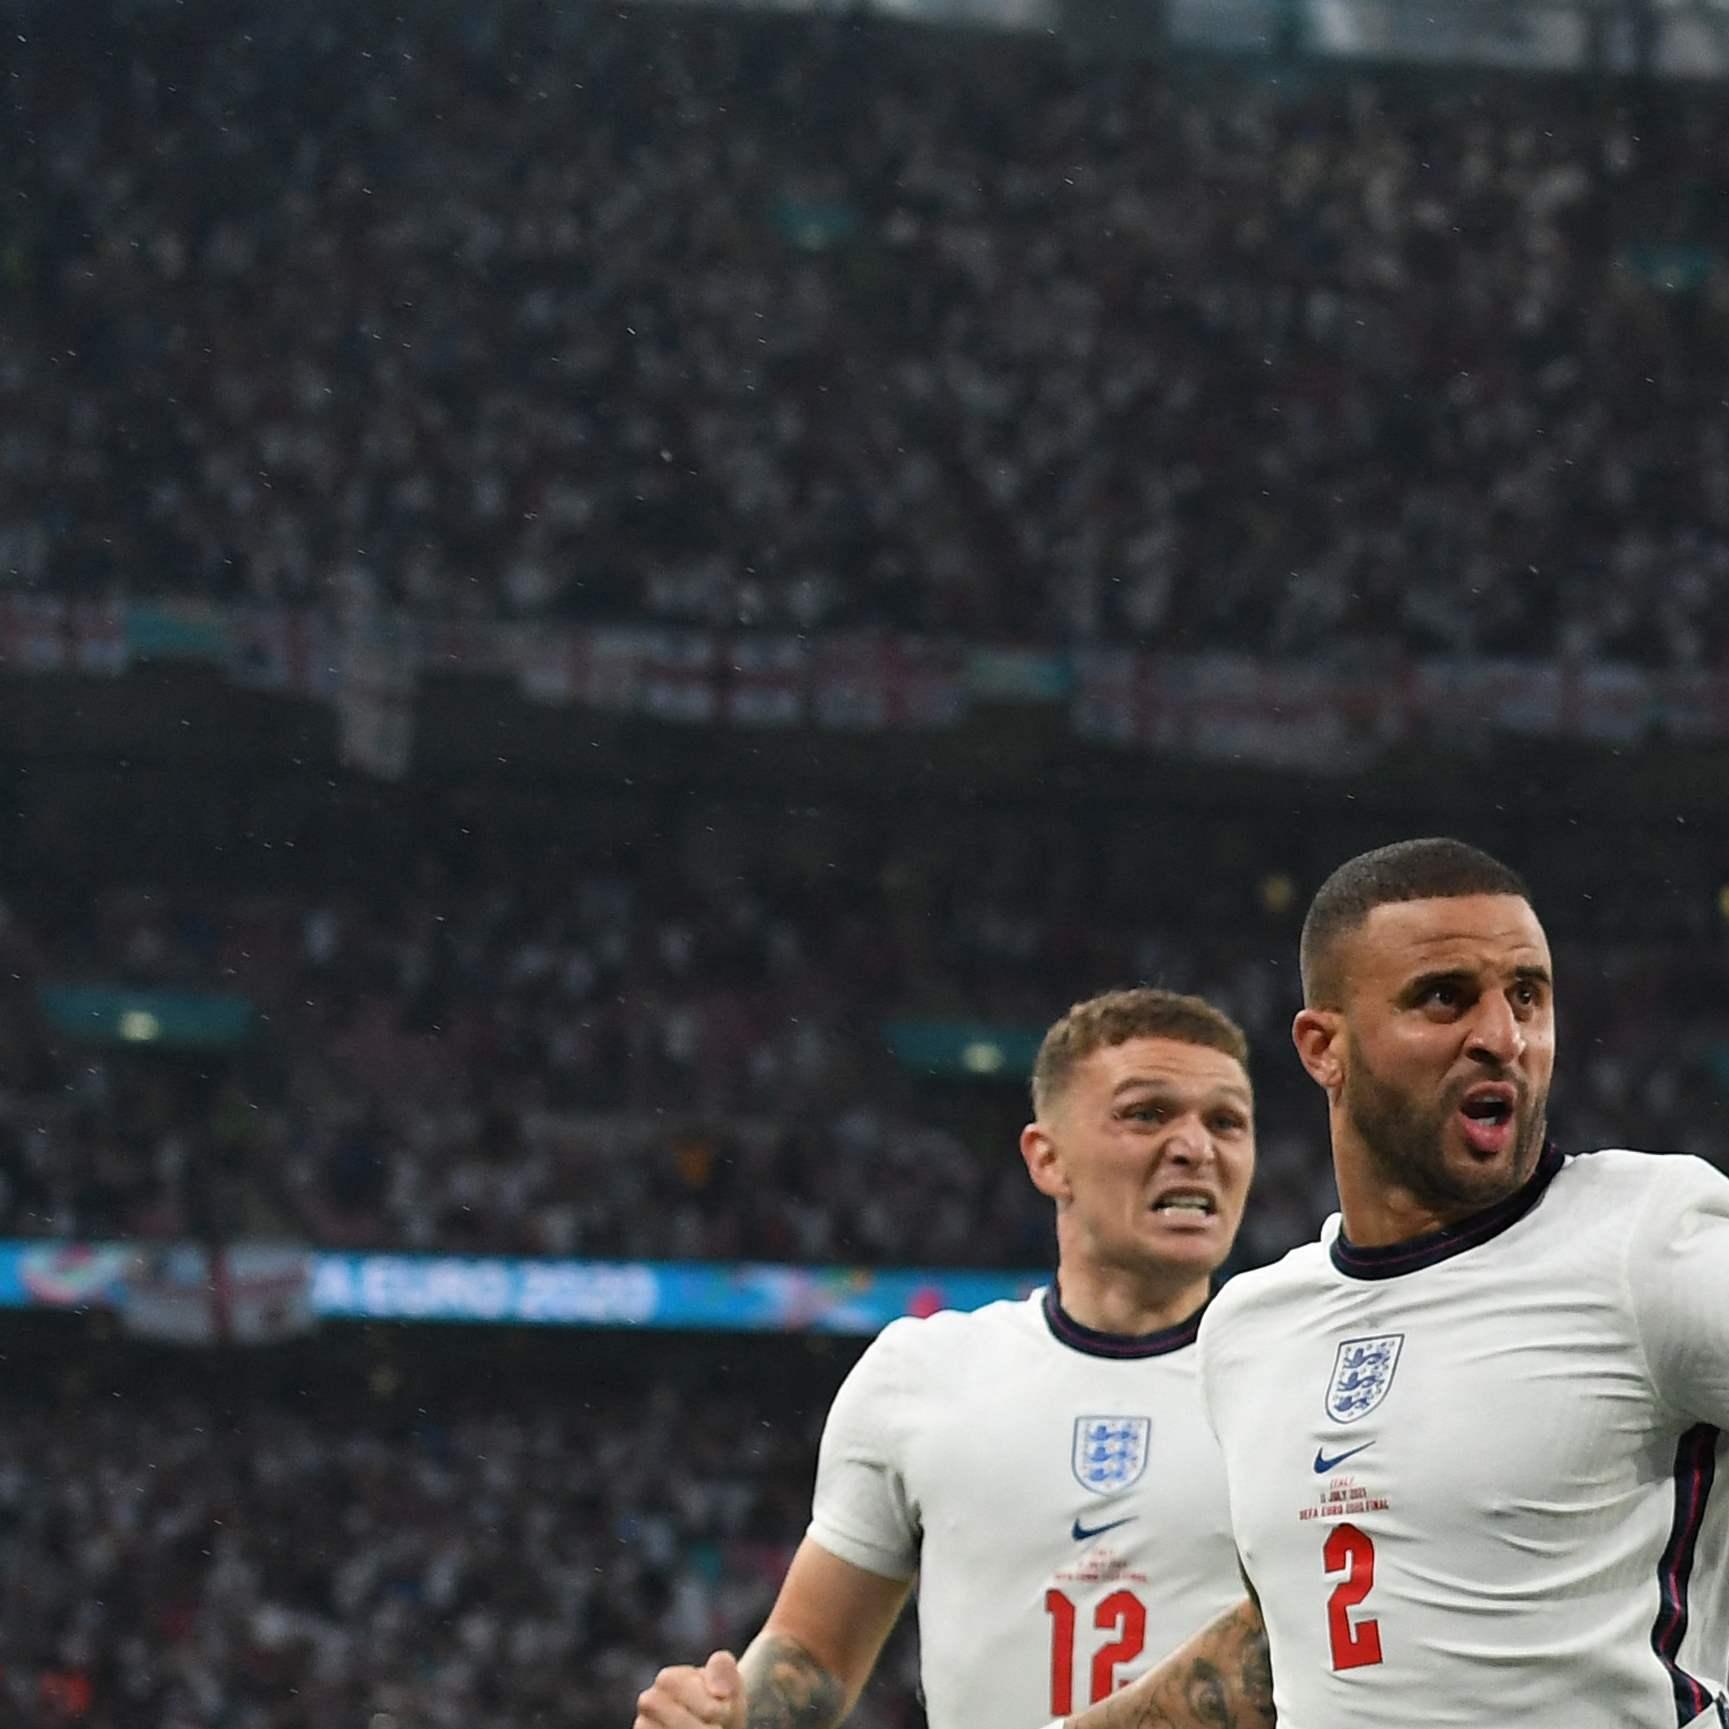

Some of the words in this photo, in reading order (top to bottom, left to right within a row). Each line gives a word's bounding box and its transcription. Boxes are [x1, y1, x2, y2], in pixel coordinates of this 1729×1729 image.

[1299, 1508, 1319, 1521] UEFA
[1320, 1503, 1344, 1517] EURO
[1328, 1490, 1348, 1503] JULY
[1323, 1522, 1384, 1672] 2
[1044, 1588, 1147, 1718] 12
